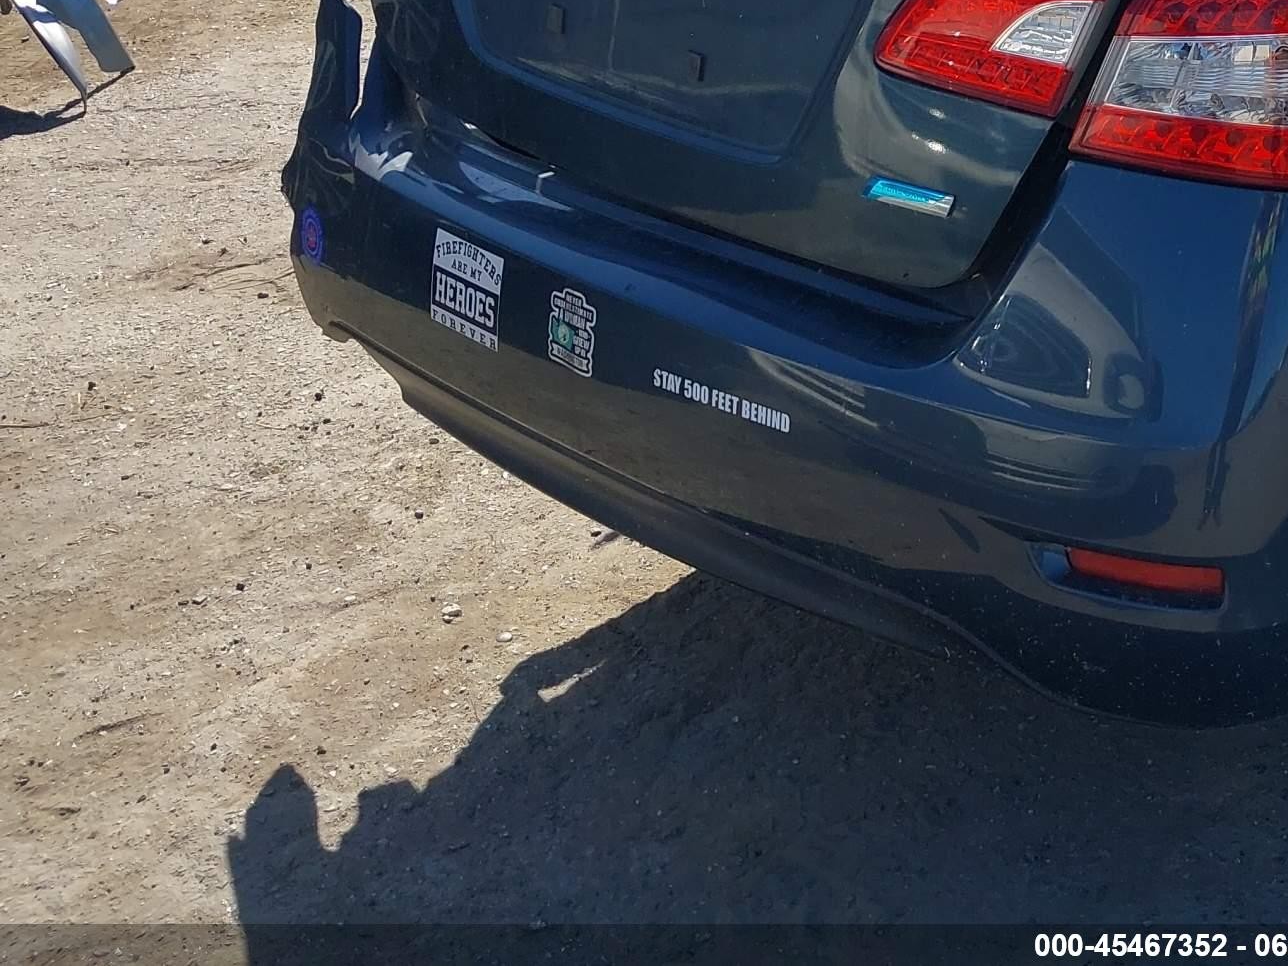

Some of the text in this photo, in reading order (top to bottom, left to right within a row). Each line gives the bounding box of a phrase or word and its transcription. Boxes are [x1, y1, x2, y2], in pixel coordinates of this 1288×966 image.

[435, 240, 501, 286] FIREFIGHTERS
[451, 258, 482, 282] ARE MY
[434, 271, 495, 328] HEROES
[432, 309, 497, 350] FOREVER
[653, 368, 791, 433] STAY 500 FEET BEHIND
